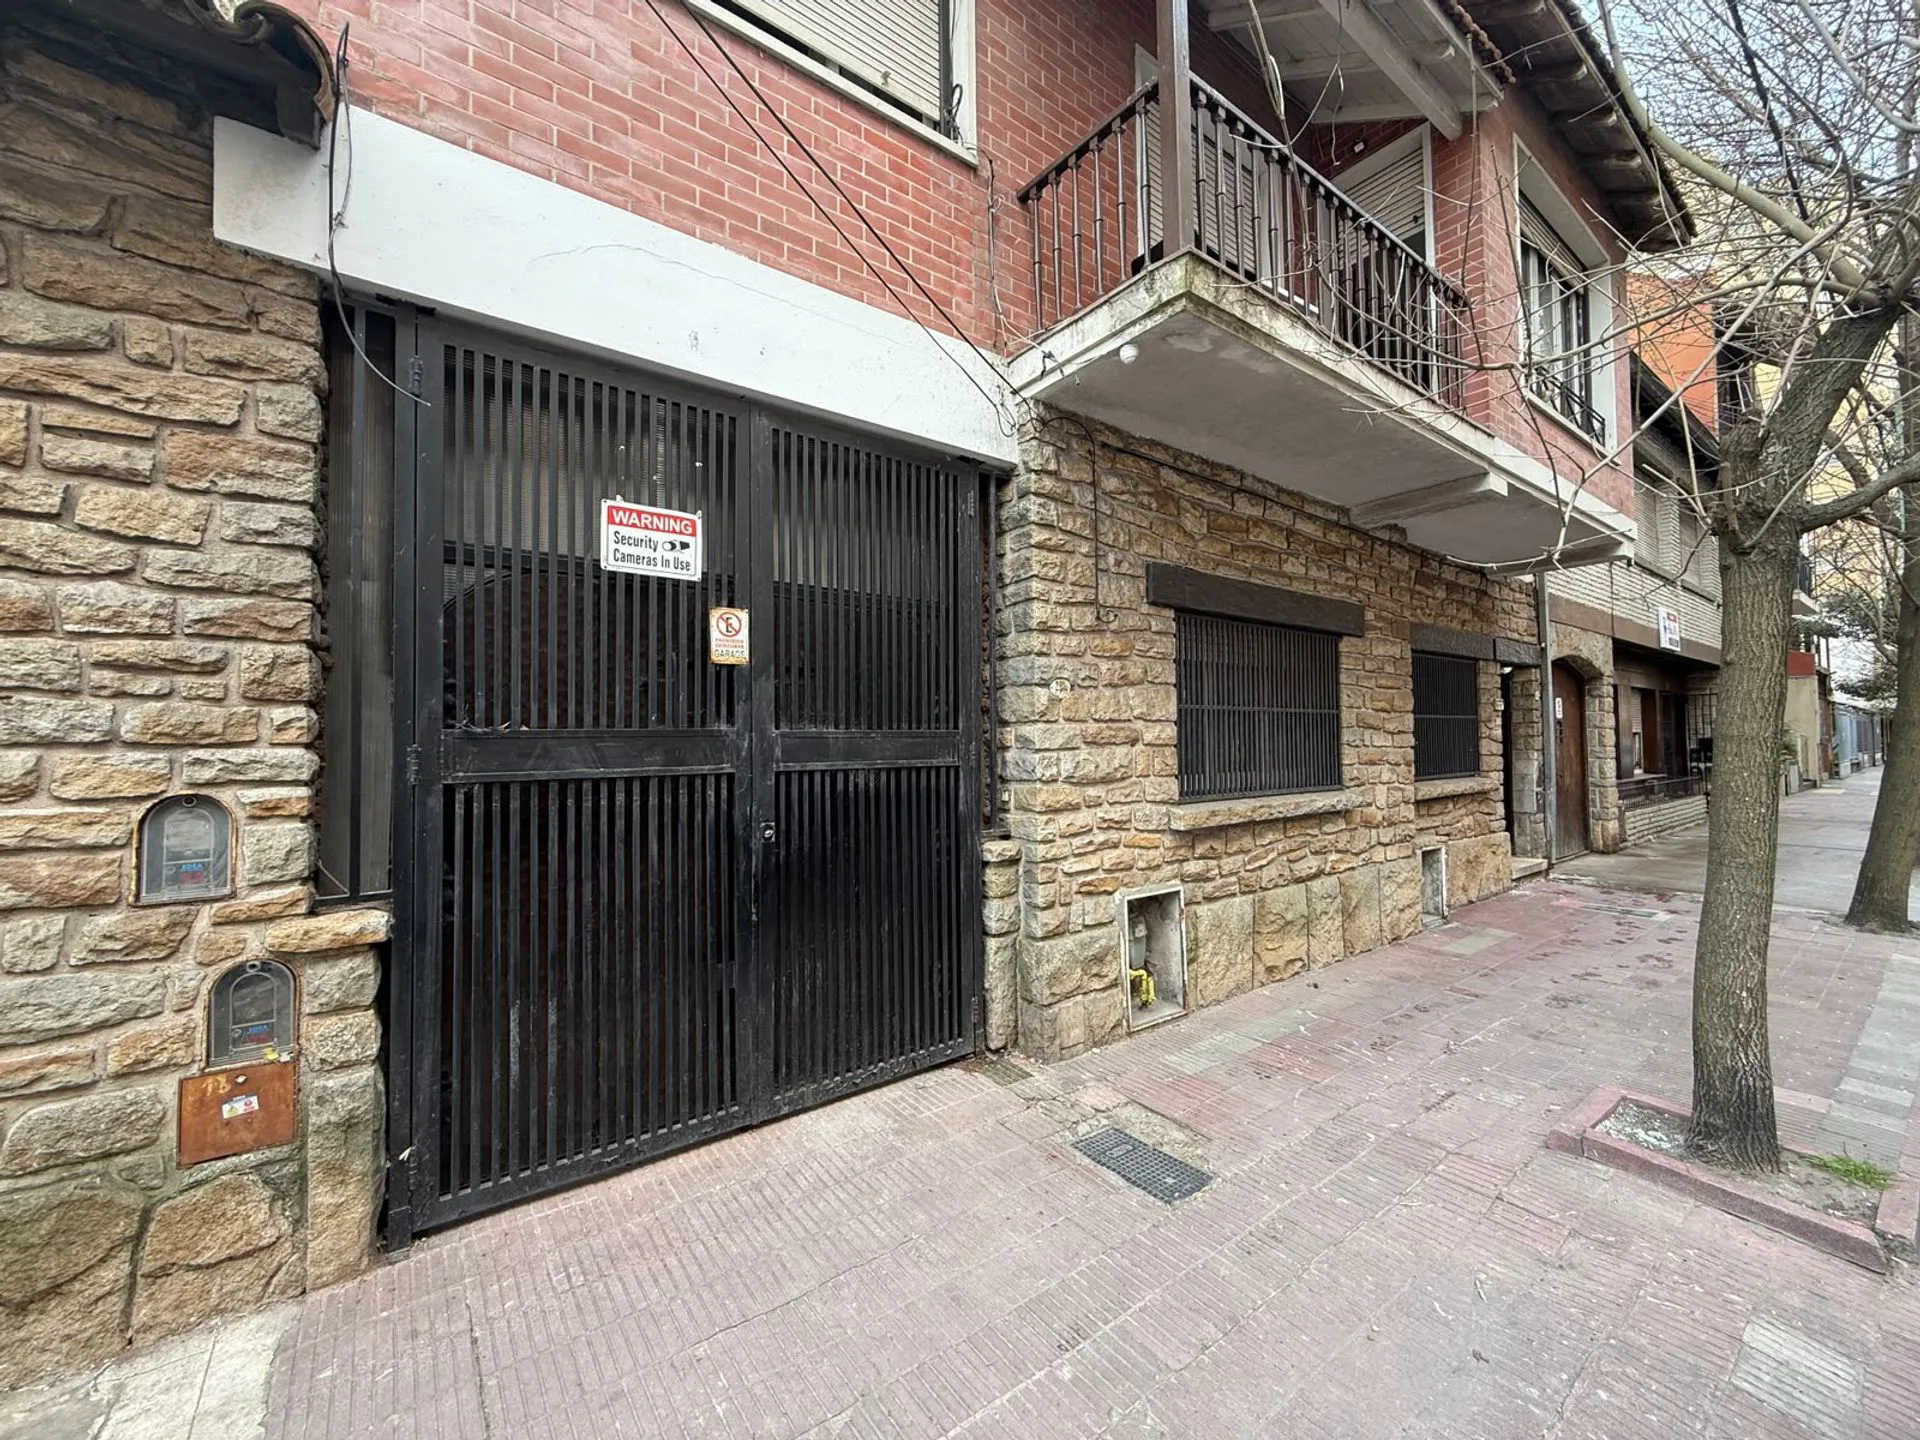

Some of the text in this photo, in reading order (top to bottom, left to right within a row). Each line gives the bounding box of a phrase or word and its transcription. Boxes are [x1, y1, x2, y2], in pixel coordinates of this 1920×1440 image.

[612, 509, 693, 535] WARNING
[613, 530, 658, 553] Security
[613, 548, 691, 572] Cameras In Use
[714, 649, 745, 659] GARAGE
